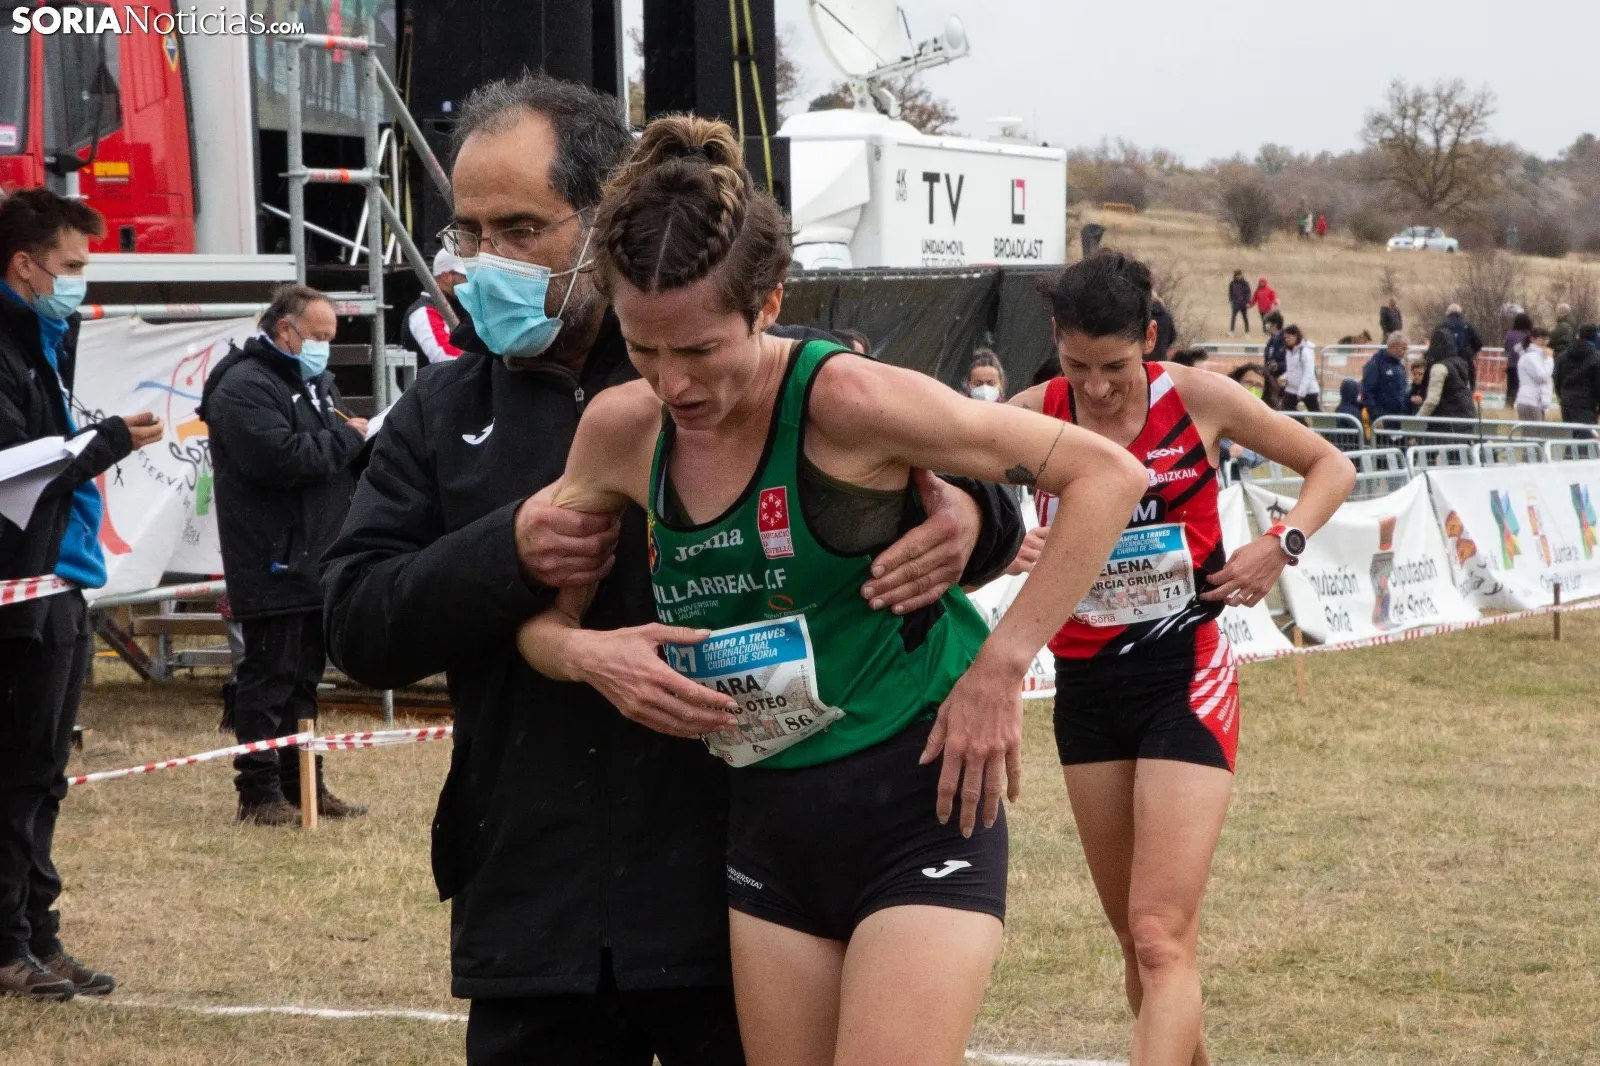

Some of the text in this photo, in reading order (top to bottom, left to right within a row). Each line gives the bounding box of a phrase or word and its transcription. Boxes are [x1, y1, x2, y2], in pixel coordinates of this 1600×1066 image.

[896, 169, 907, 188] 4K
[922, 171, 965, 227] TV
[994, 237, 1043, 260] BROADCAST
[1157, 468, 1198, 484] BIZKAIA
[674, 528, 744, 562] Joma
[652, 573, 764, 606] ILLARREAL
[1163, 584, 1181, 599] 74
[674, 599, 719, 615] UNIVERSITAT
[677, 608, 702, 621] JAUME
[1090, 613, 1116, 624] Soria
[702, 637, 737, 653] CAMPO
[738, 635, 746, 646] A
[749, 627, 786, 643] TRAVÉS
[704, 641, 770, 661] INTERNACIONAL
[707, 648, 778, 671] CIUDAD DE SORIA
[701, 674, 762, 696] ARA
[745, 694, 788, 713] OTEO
[784, 714, 813, 731] 86
